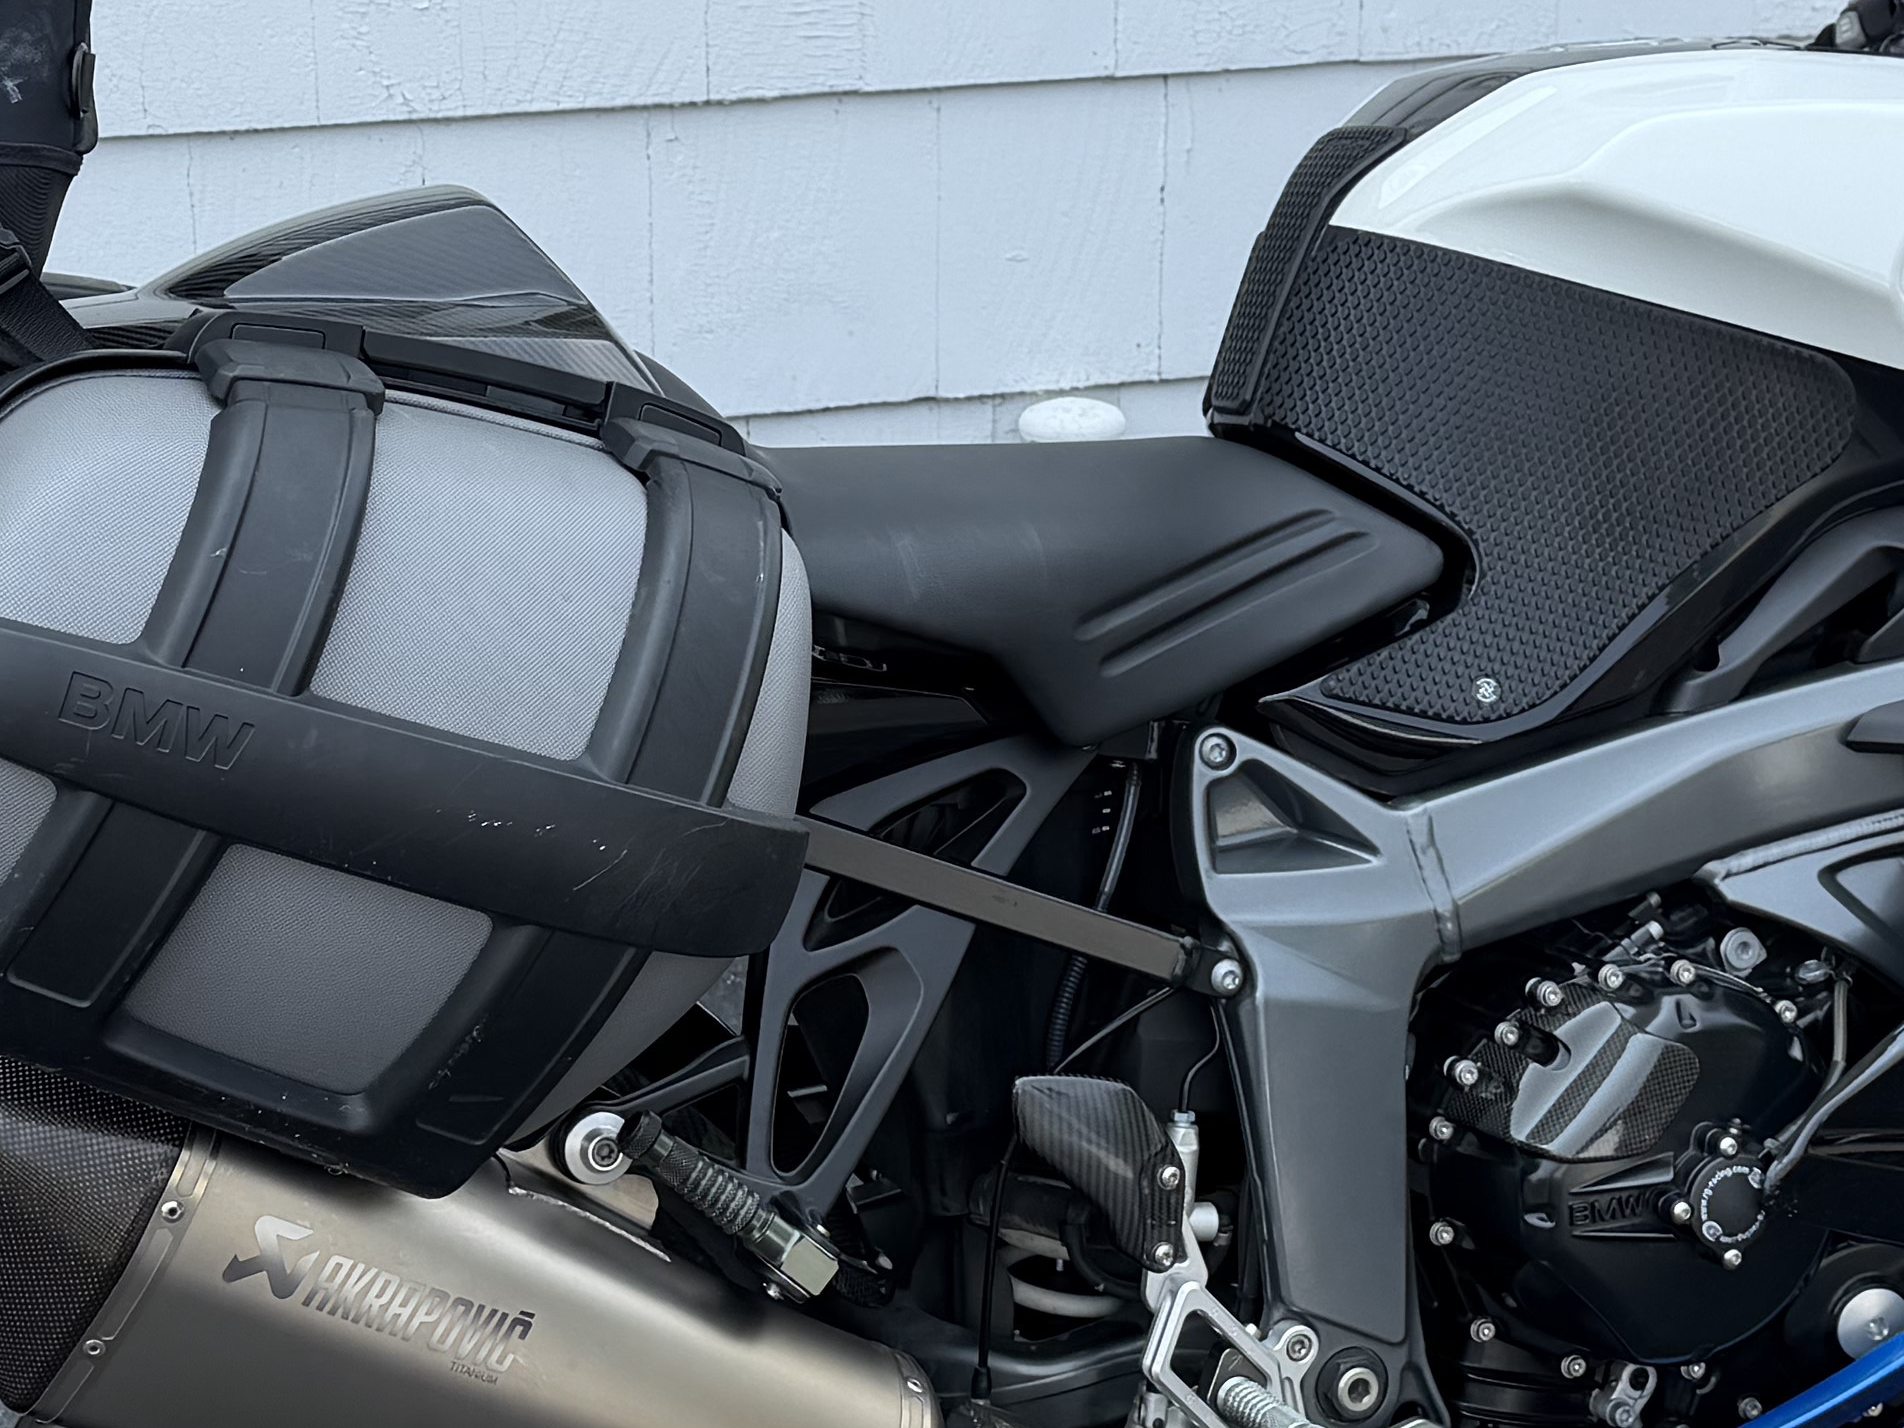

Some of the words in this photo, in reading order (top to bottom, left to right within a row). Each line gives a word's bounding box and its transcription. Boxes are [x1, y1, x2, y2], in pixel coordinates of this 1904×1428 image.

[59, 671, 255, 770] BMW
[1568, 1193, 1645, 1228] BMW
[449, 1360, 499, 1386] TITANIUM
